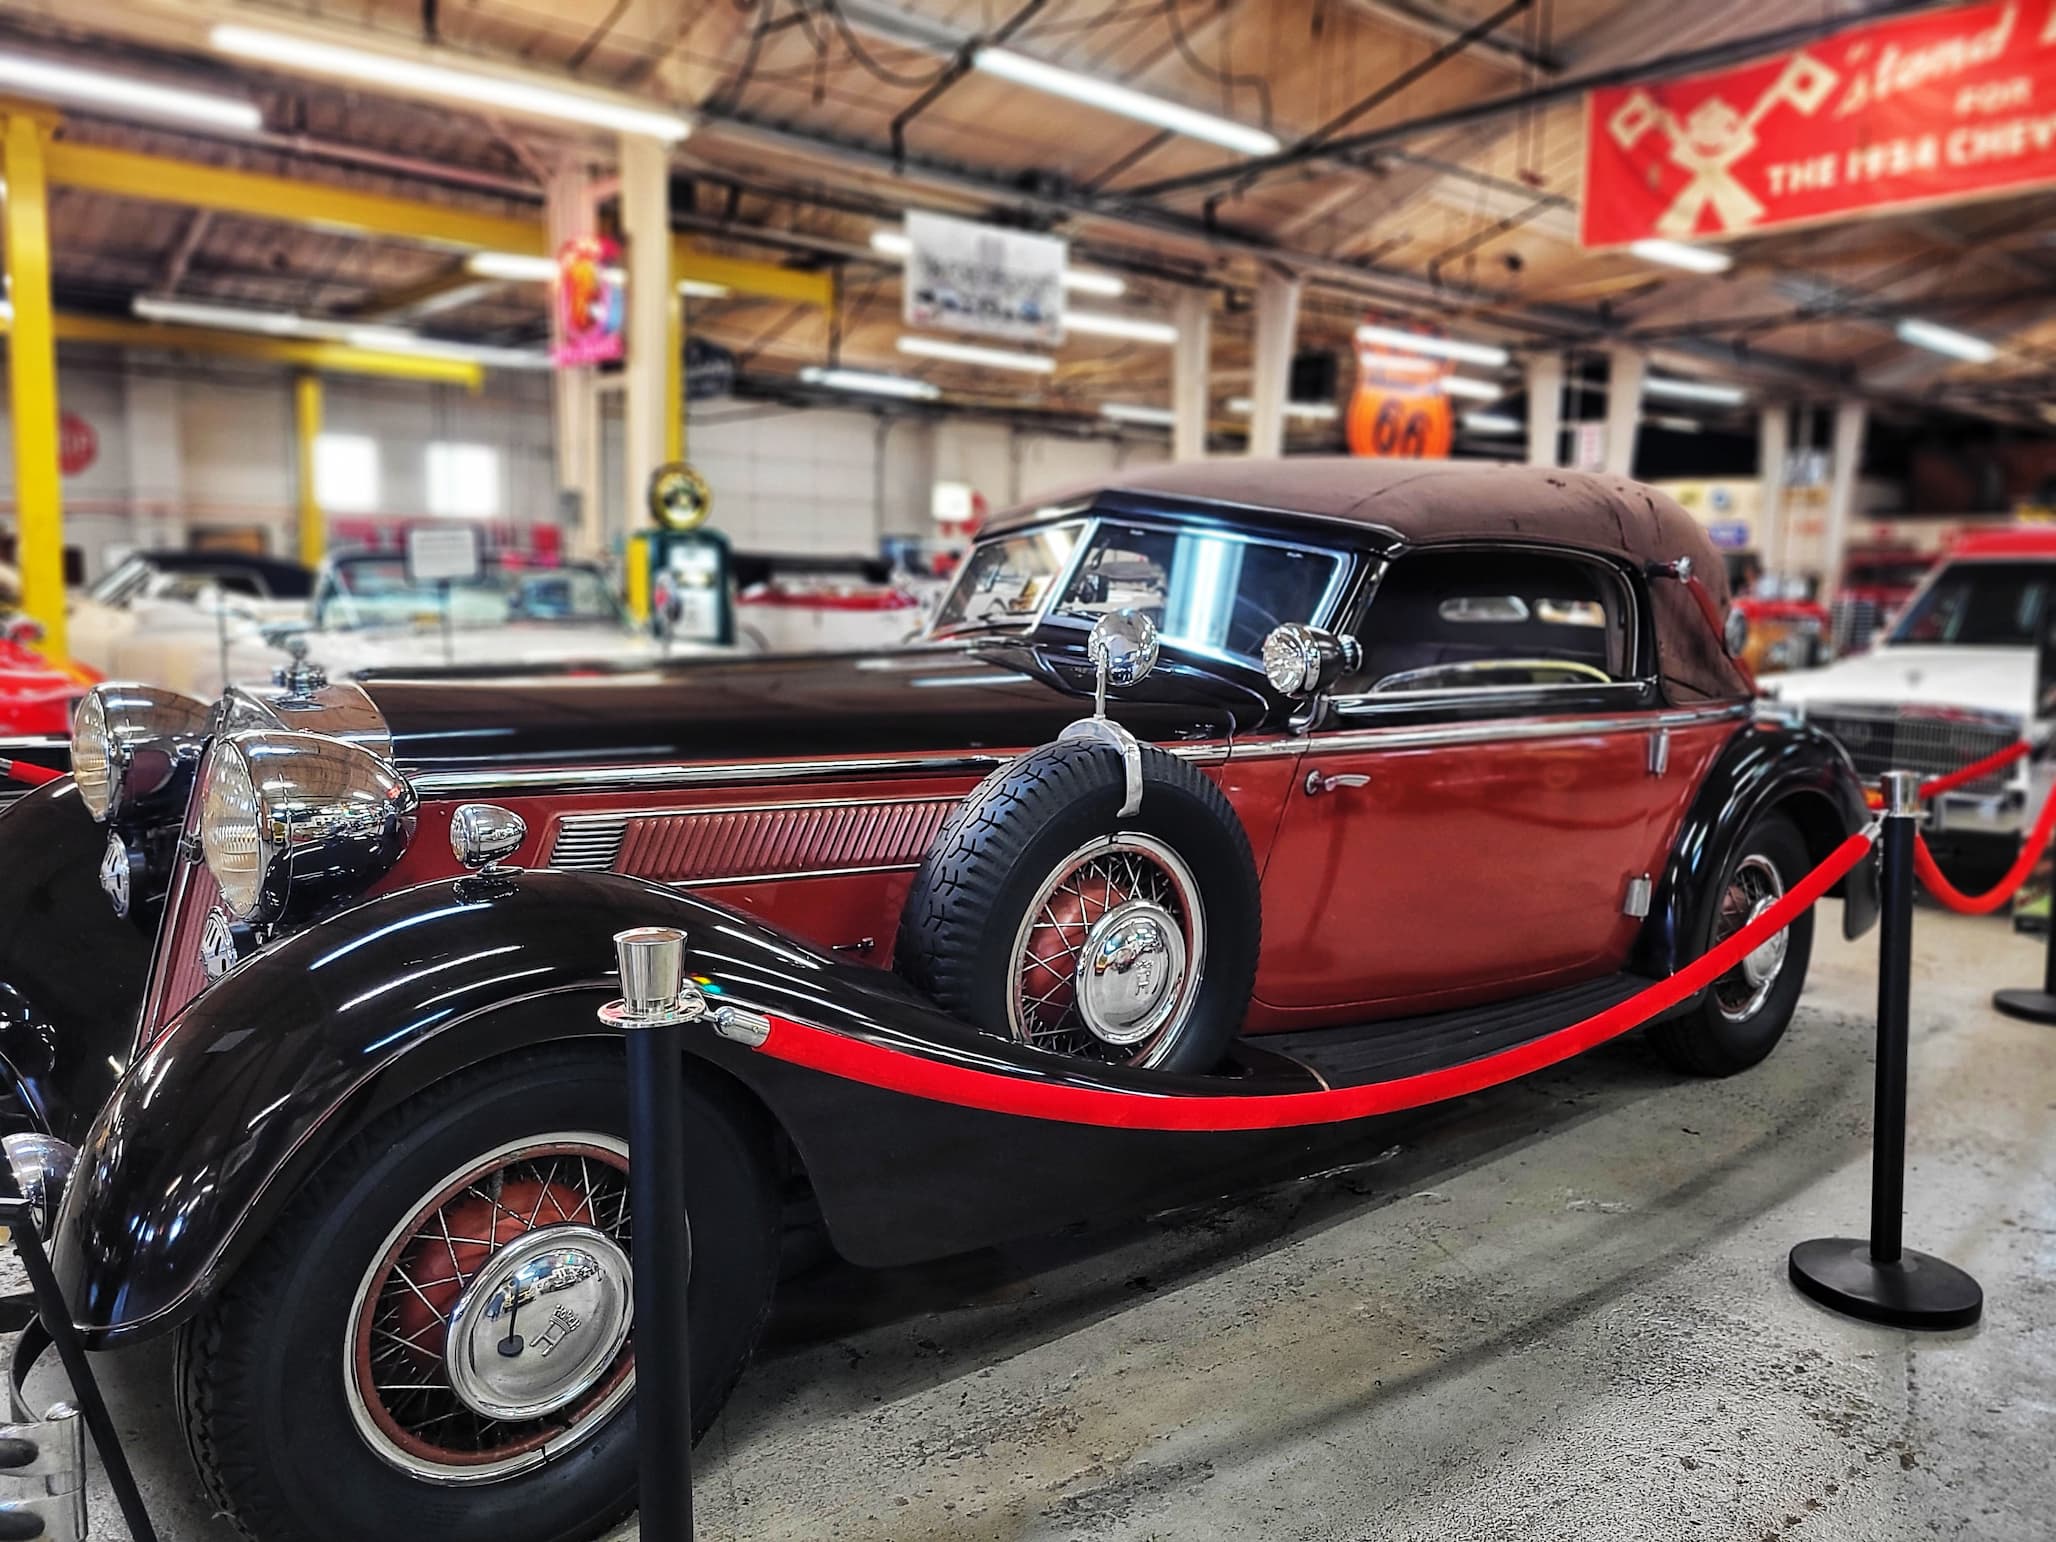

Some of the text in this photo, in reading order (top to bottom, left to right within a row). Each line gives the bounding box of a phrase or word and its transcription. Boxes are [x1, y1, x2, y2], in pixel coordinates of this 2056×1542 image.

[1954, 76, 2032, 116] FOR
[1767, 153, 1837, 196] THE
[1846, 136, 1938, 182] 1934
